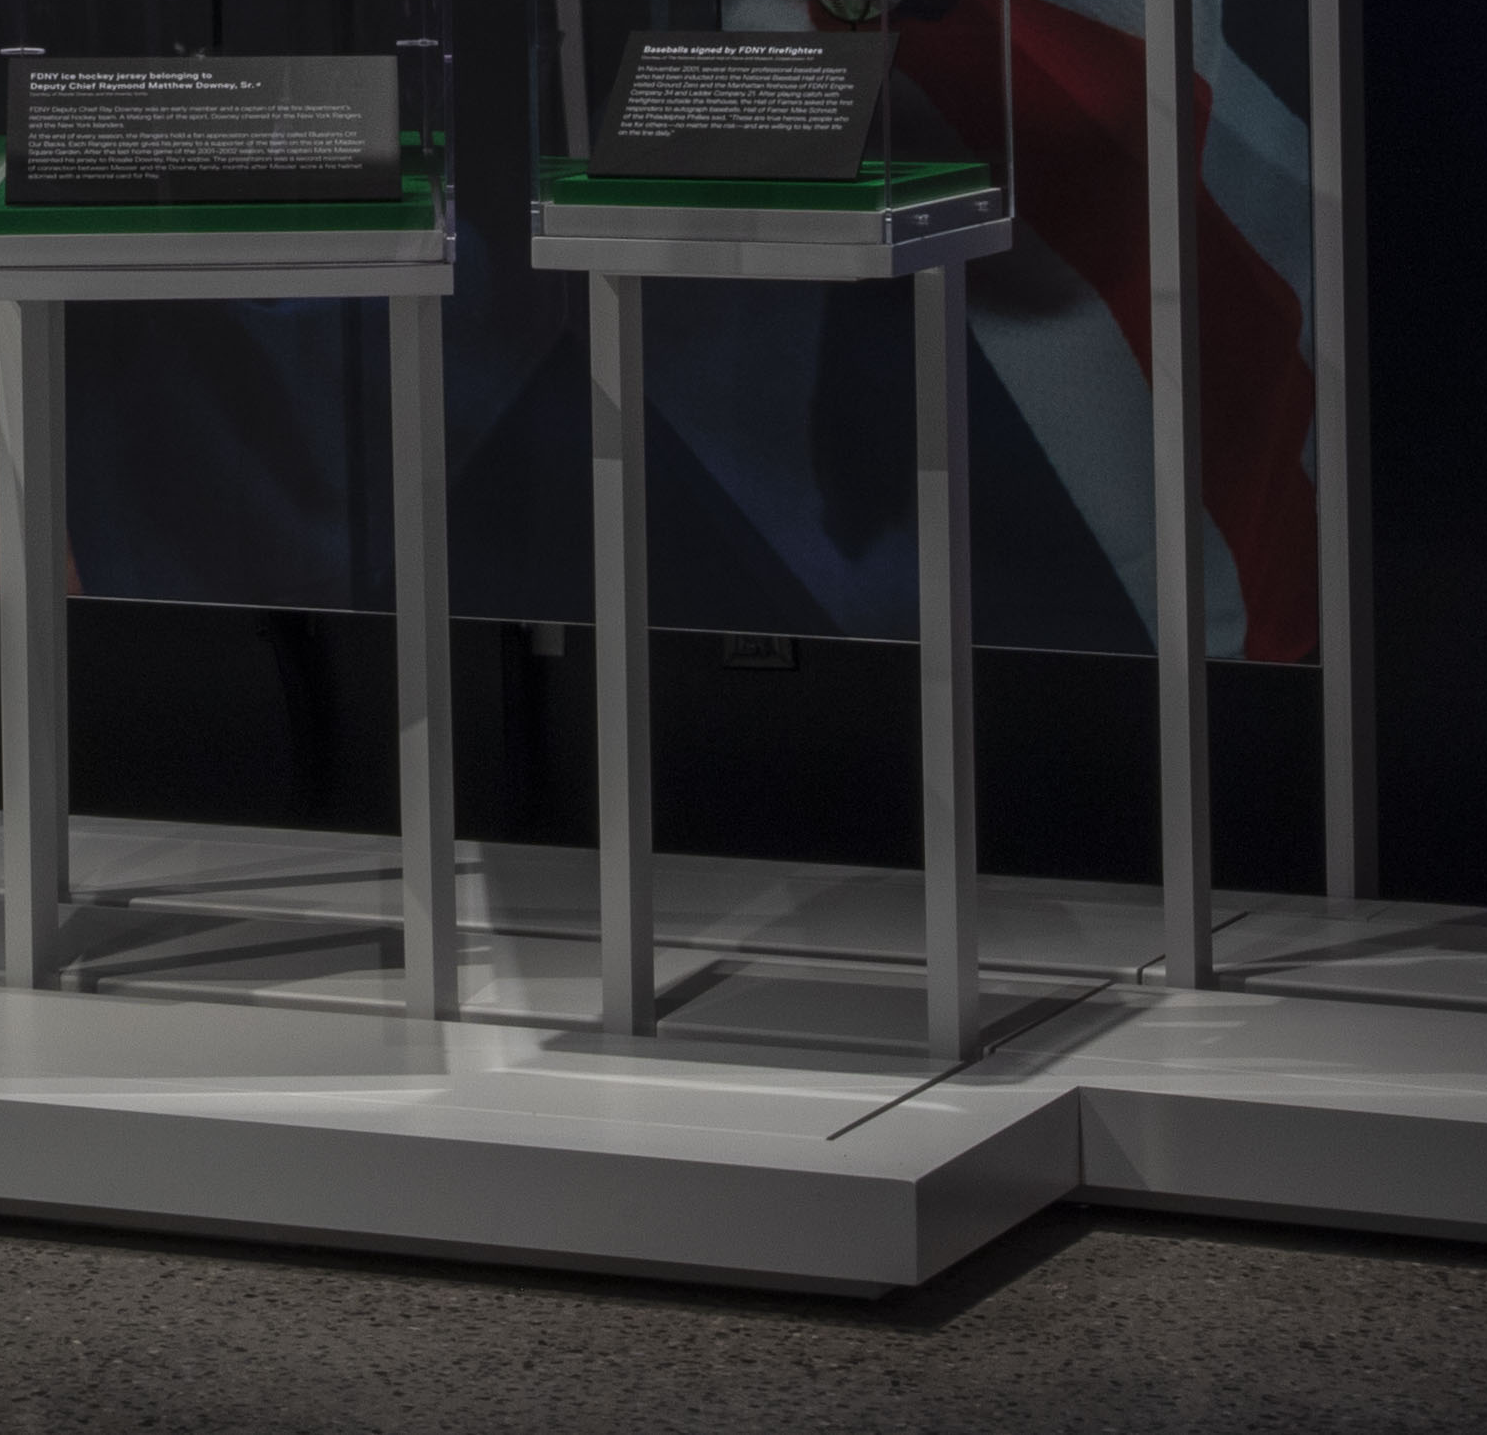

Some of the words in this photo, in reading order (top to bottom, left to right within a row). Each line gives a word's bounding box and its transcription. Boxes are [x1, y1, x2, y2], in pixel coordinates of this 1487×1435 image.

[690, 46, 722, 55] signed
[725, 47, 736, 55] by
[768, 47, 823, 55] firefighters
[30, 72, 59, 81] FDNY
[61, 72, 76, 81] ice
[79, 72, 114, 82] hockey
[116, 72, 147, 81] jersey
[150, 72, 199, 81] belonging
[202, 72, 212, 80] to
[30, 82, 65, 91] Deputy
[69, 82, 96, 90] Chief
[99, 81, 145, 91] Raymond
[148, 81, 193, 90] Matthew
[196, 81, 237, 90] Downey,
